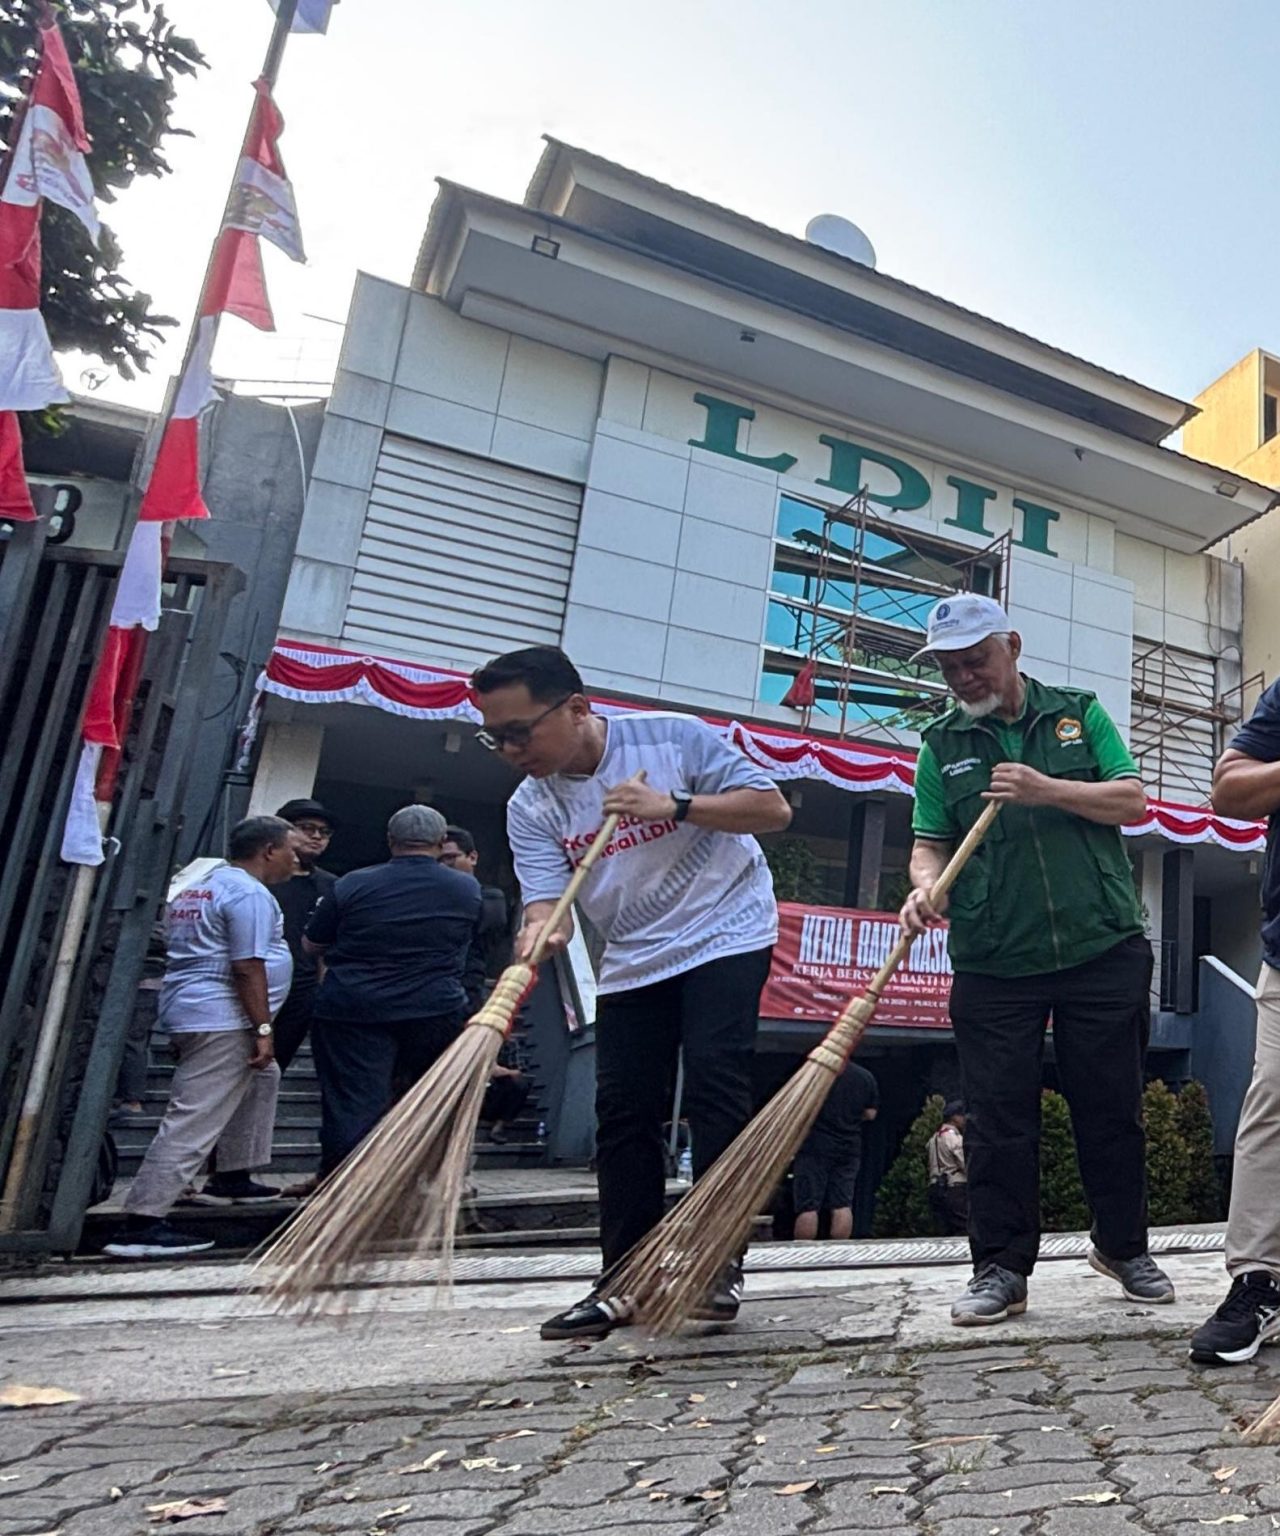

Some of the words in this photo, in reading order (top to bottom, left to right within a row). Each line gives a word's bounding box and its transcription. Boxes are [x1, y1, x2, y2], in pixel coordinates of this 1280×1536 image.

[687, 392, 1060, 558] LDII
[639, 818, 679, 843] LDII
[800, 914, 853, 966] KERJA
[793, 963, 833, 978] KERJA
[836, 968, 897, 984] BERSAA
[900, 973, 938, 987] BAKTI
